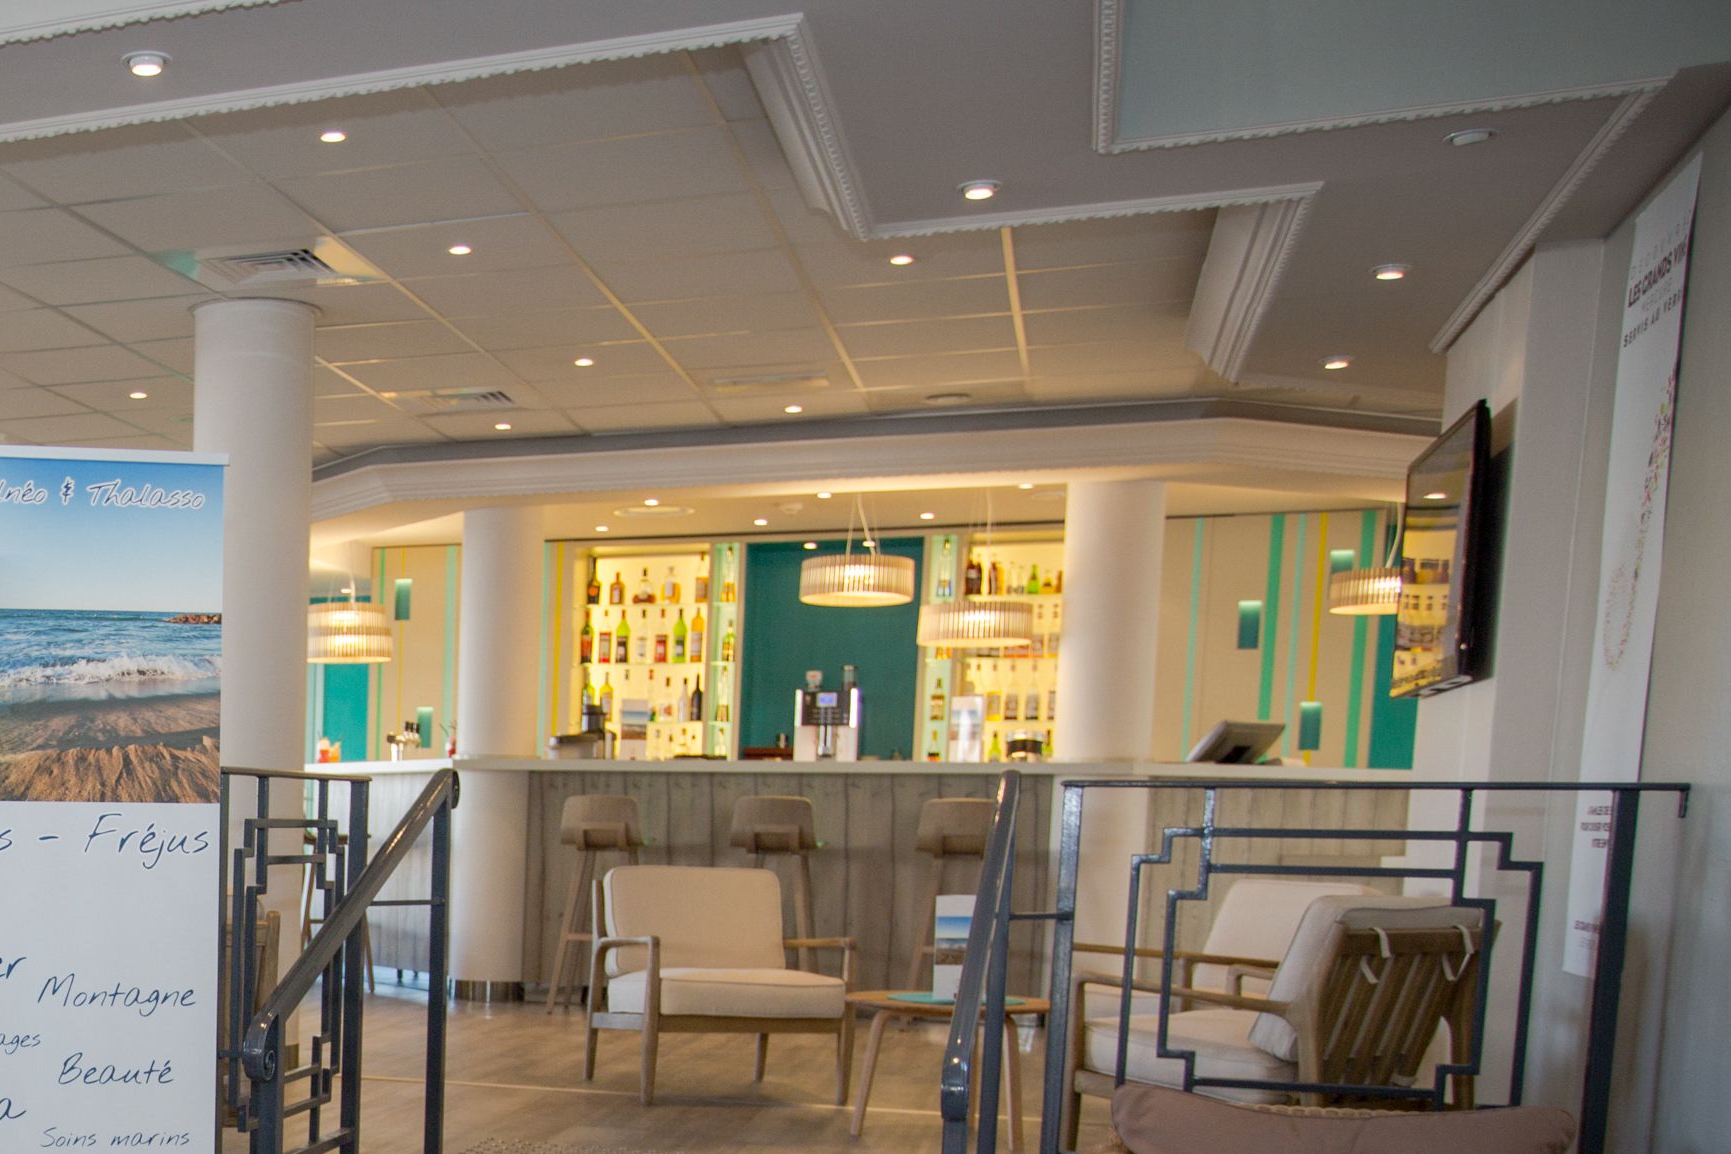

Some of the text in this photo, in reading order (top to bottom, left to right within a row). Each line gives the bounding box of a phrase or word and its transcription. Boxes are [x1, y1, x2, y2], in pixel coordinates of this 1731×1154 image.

[61, 477, 75, 505] &
[87, 479, 206, 509] Thalasso
[84, 812, 209, 870] Fréjus
[36, 972, 197, 1018] Montagne
[57, 1051, 175, 1085] Beauté
[39, 1126, 191, 1149] Soins marins
